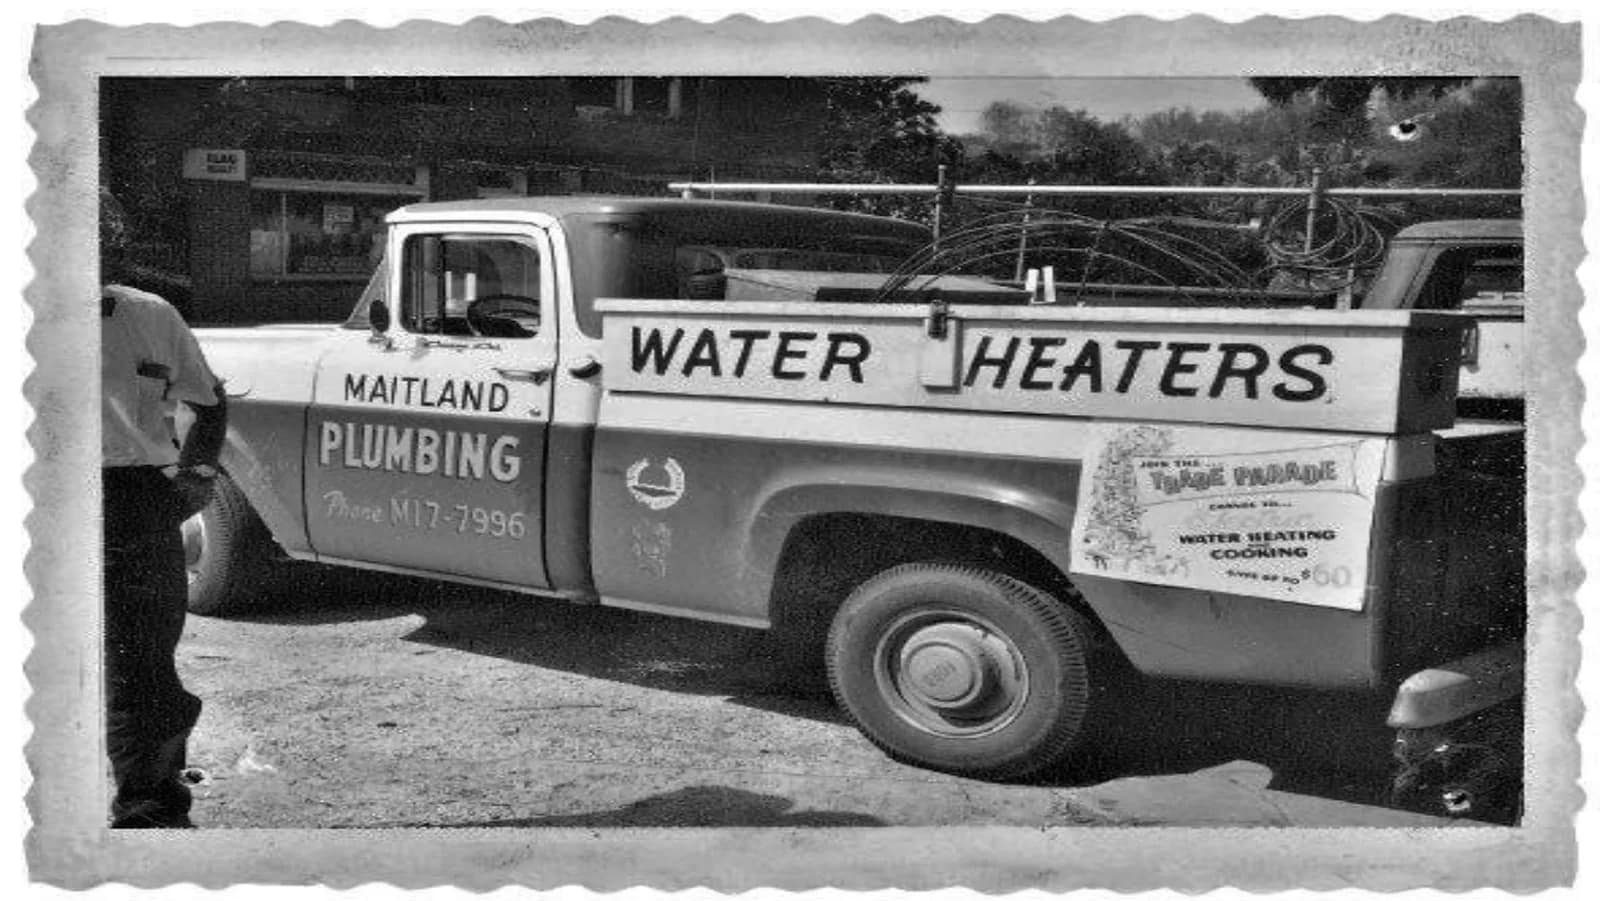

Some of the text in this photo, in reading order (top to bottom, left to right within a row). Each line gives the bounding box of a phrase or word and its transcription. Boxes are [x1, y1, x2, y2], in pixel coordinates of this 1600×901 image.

[631, 325, 1335, 403] WATER HEATERS
[344, 373, 510, 413] MAITLAND
[319, 421, 522, 483] PLUMBING
[1233, 460, 1339, 487] PARADE
[1179, 532, 1241, 545] WATER
[1246, 529, 1337, 543] HEATING
[1209, 546, 1309, 560] COOKING
